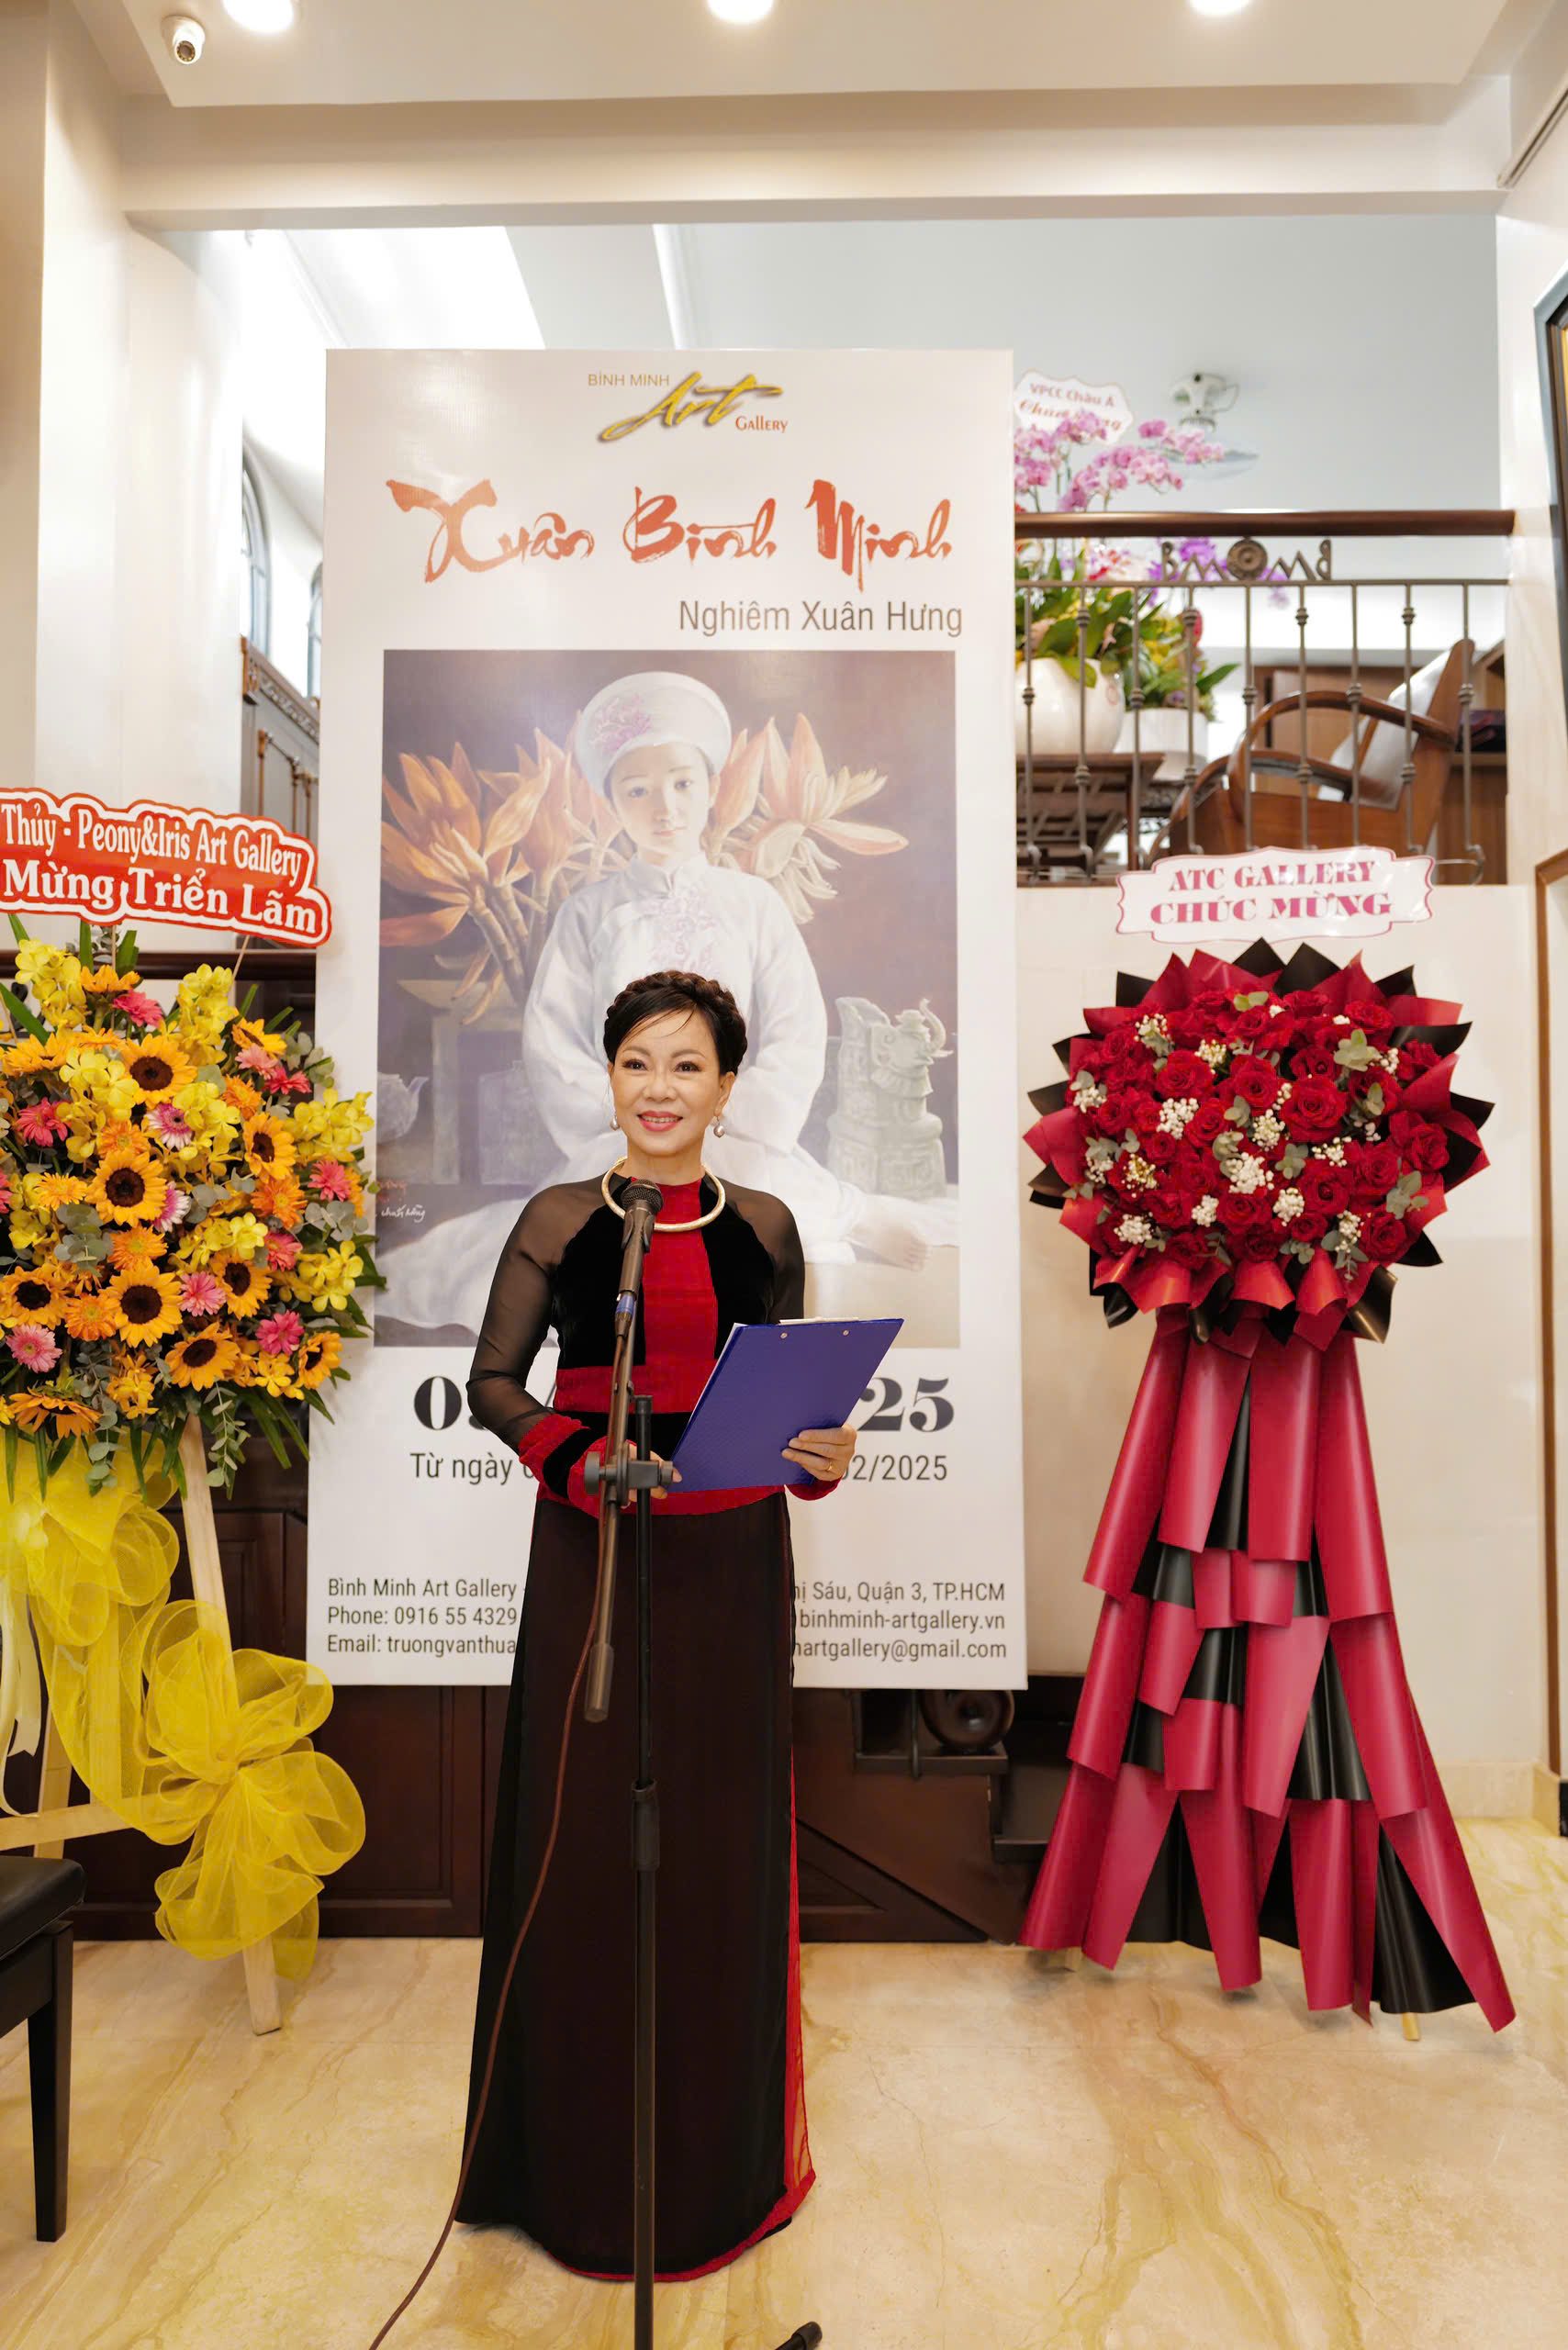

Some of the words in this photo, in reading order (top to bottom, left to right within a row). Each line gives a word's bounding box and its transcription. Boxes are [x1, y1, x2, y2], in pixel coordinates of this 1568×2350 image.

[630, 374, 669, 386] MINH
[598, 370, 783, 442] Art
[386, 479, 595, 583] Xuân
[804, 479, 953, 593] Minh
[679, 600, 790, 637] Nghiêm
[801, 600, 873, 631] Xuân
[887, 601, 962, 637] Hưng
[1, 802, 56, 856] Thủy
[196, 823, 228, 866] Art
[234, 829, 303, 887] Gallery
[1169, 867, 1224, 892] ATC
[1234, 860, 1375, 888] GALLERY
[4, 859, 115, 910] Mừng
[129, 867, 229, 915] Triển
[241, 883, 317, 934] Lãm
[1150, 895, 1257, 925] CHÚC
[1271, 890, 1393, 919] MỪNG
[410, 1451, 444, 1479] Từ
[452, 1452, 513, 1485] ngày
[842, 1455, 947, 1482] 2/2025
[328, 1576, 367, 1596] Bình
[374, 1576, 416, 1596] Minh
[422, 1578, 449, 1596] Art
[455, 1578, 517, 1601] Gallery
[813, 1581, 852, 1604] Sáu,
[857, 1581, 904, 1604] Quận
[912, 1583, 927, 1603] 3,
[934, 1583, 1004, 1601] TP.HCM
[328, 1606, 388, 1625] Phone:
[395, 1607, 439, 1626] 0916
[445, 1608, 467, 1626] 55
[473, 1608, 518, 1627] 4329
[328, 1634, 382, 1653] Email:
